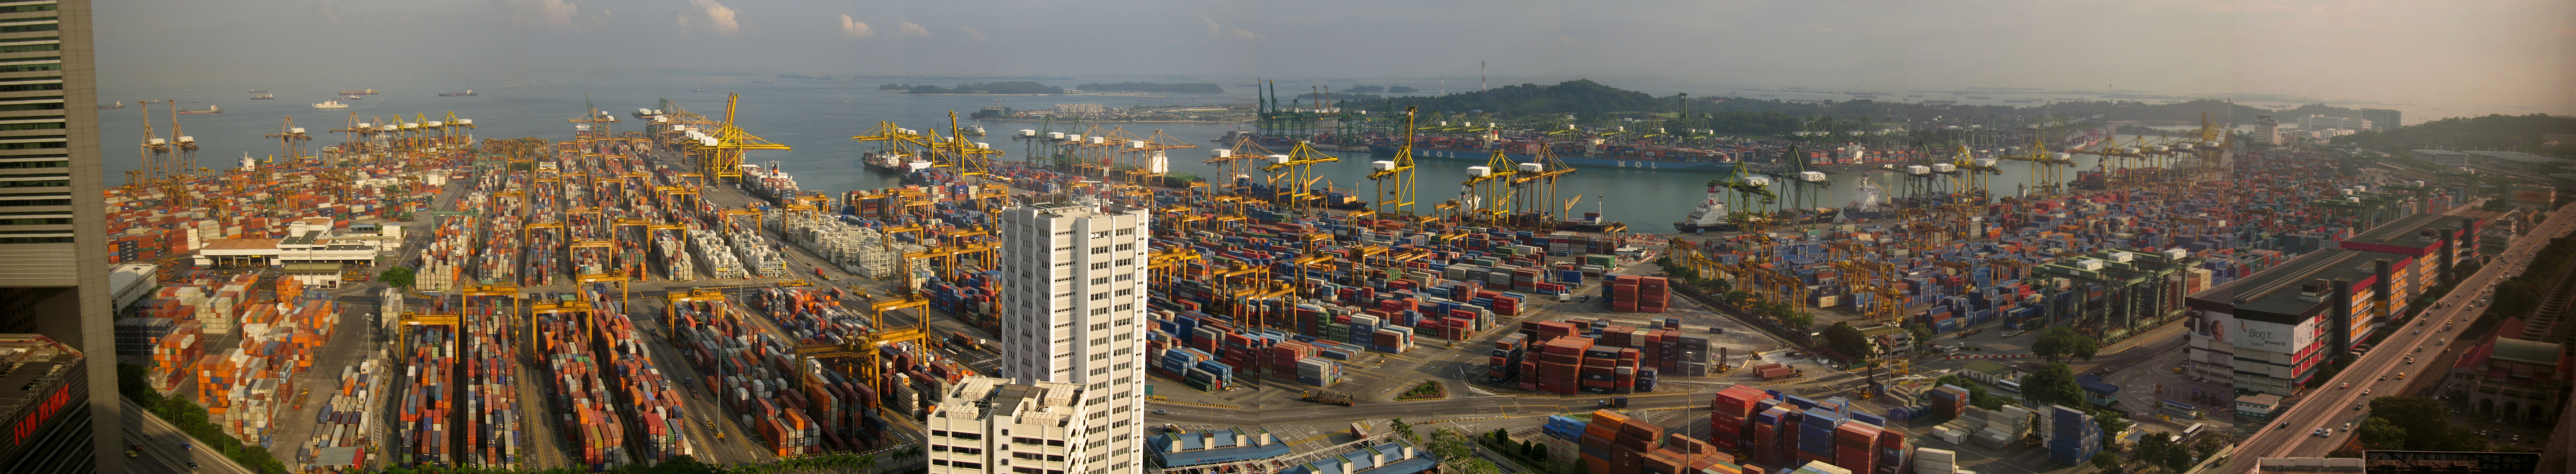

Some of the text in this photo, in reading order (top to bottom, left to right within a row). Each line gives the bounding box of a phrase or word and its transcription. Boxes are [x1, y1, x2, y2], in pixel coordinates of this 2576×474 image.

[1617, 161, 1657, 169] MOL
[2250, 329, 2265, 340] Blog
[2267, 331, 2272, 339] it
[15, 383, 70, 445] FUJI XEROX
[1550, 438, 1560, 446] IRISL
[1550, 445, 1560, 454] IRISL
[1550, 453, 1560, 461] IRISL
